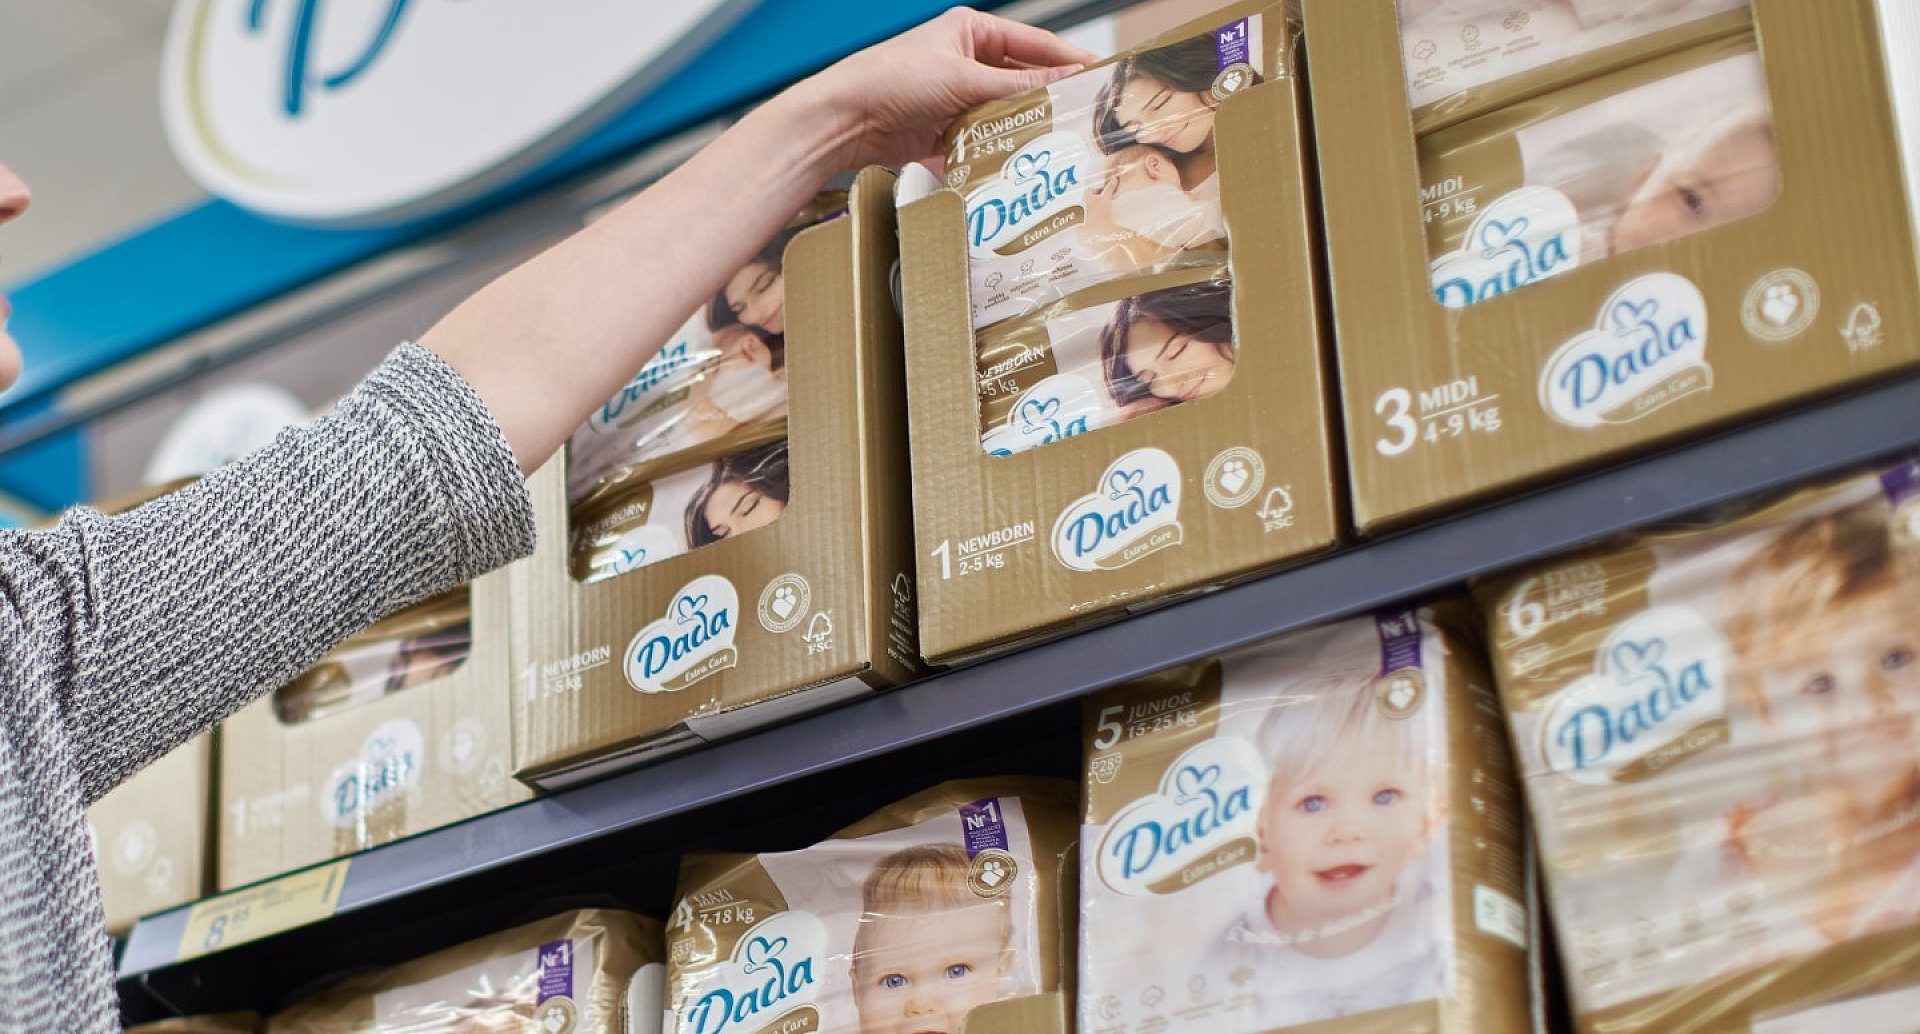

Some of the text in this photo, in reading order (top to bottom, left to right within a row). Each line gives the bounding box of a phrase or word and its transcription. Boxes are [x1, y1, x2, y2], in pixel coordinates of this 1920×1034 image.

[970, 107, 1045, 140] NEWBORN
[948, 127, 965, 165] 1
[972, 137, 1015, 158] 2-5 kg
[969, 165, 1078, 247] Dada
[1420, 176, 1463, 201] MIDI
[1456, 196, 1476, 216] kg
[1023, 212, 1075, 246] Extra Care
[1560, 317, 1697, 408] Dada
[1000, 378, 1019, 394] kg
[1419, 376, 1477, 412] MIDI
[1374, 387, 1417, 455] 3
[1423, 402, 1503, 444] 4-9 kg
[959, 522, 1034, 554] NEWBORN
[1067, 483, 1172, 558] Dada
[930, 540, 951, 579] 1
[959, 552, 1005, 575] 2-5 kg
[1123, 543, 1149, 561] Extra
[1508, 578, 1545, 638] 6
[637, 606, 730, 679] Dada
[808, 640, 833, 655] FSC
[544, 645, 610, 677] NEWBORN
[685, 654, 728, 683] Extra Care
[520, 663, 536, 701] 1
[1128, 692, 1193, 723] JUNIOR
[1176, 710, 1197, 727] kg
[1557, 660, 1709, 769] Dada
[1094, 705, 1124, 750] 5
[1112, 785, 1252, 879] Dada
[676, 897, 693, 933] 4
[694, 889, 734, 907] MAXI
[736, 906, 755, 924] kg
[688, 957, 815, 1034] Dada
